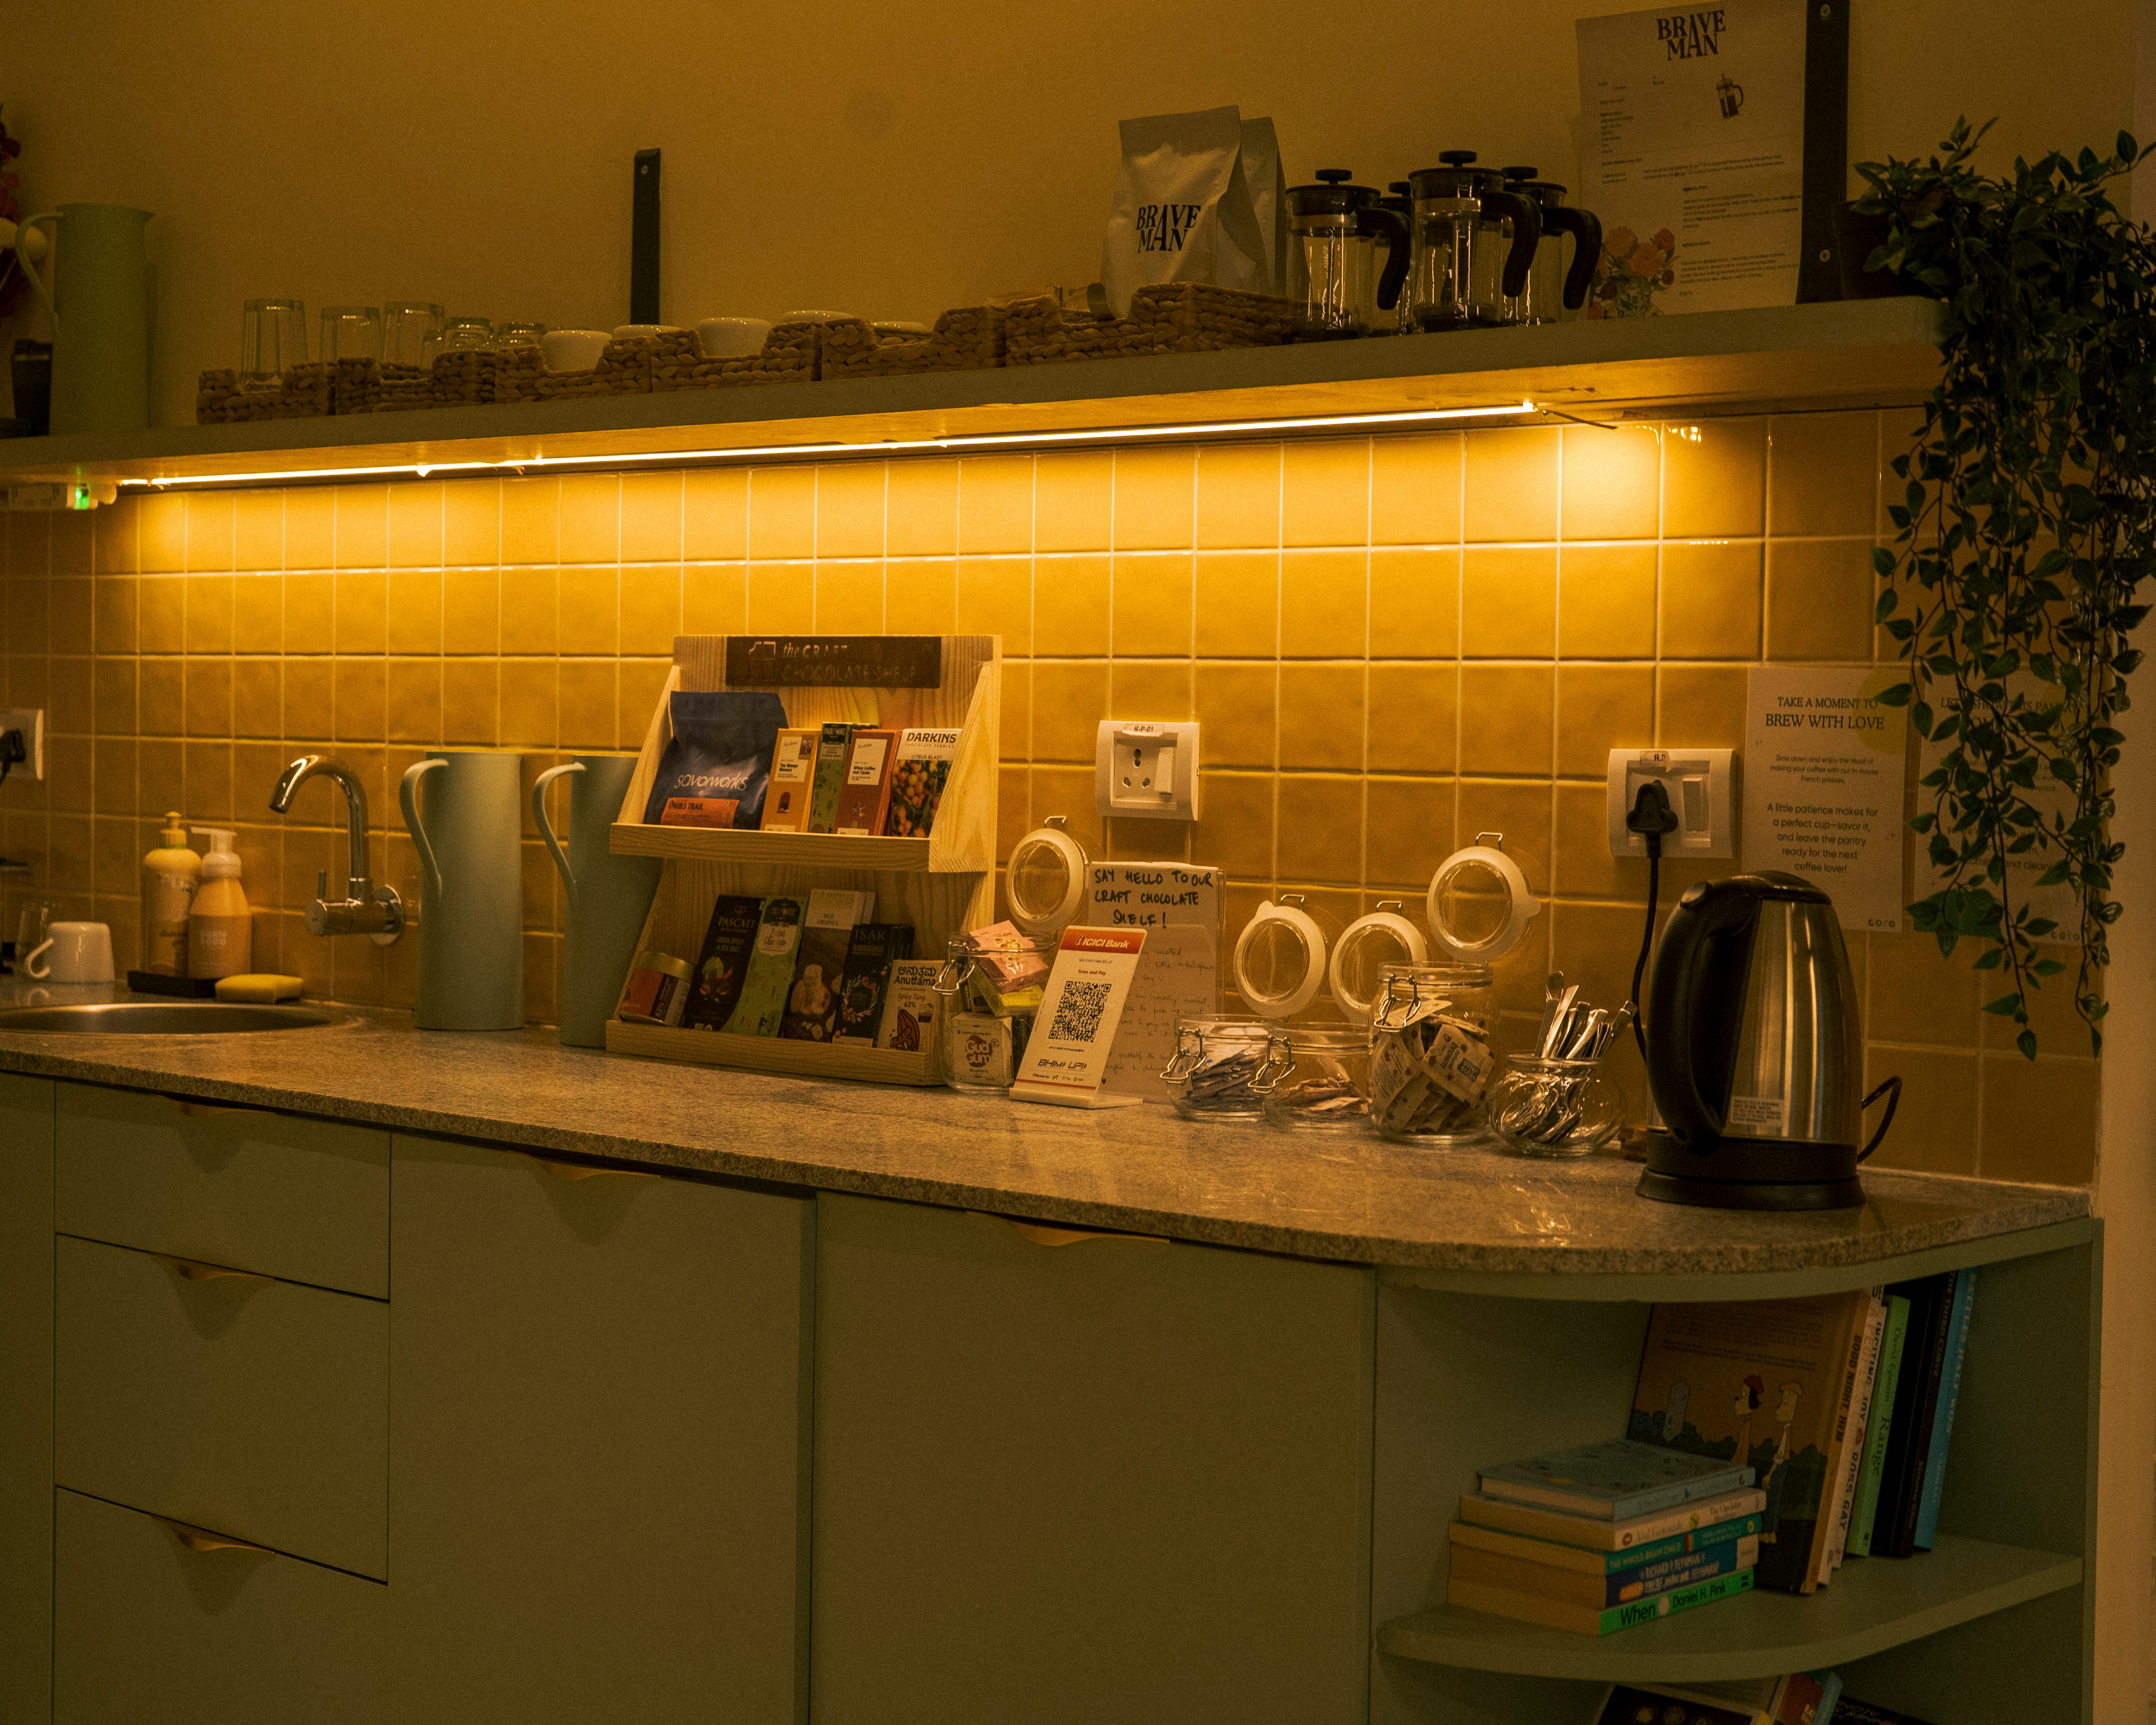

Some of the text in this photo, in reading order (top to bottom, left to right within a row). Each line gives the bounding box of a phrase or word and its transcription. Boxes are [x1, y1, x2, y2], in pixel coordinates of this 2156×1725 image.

[1656, 10, 1726, 40] BRAVE
[1667, 34, 1719, 60] MAN
[1135, 204, 1201, 230] BRAVE
[1138, 229, 1188, 253] MAN
[783, 642, 847, 659] the CRAFT
[1777, 697, 1878, 710] TAKE A MOMENT TO
[1766, 714, 1885, 730] BREW WITH LOVE
[906, 733, 956, 743] DARKINS
[674, 772, 749, 791] savorworks
[688, 802, 703, 810] TRAIL
[1767, 803, 1877, 817] A little patience makes for
[1781, 818, 1811, 828] perfect
[1863, 822, 1871, 832] it,
[1777, 833, 1866, 846] and leave the pantry
[1782, 848, 1806, 858] ready
[1809, 848, 1820, 857] for
[1823, 849, 1836, 858] the
[1794, 862, 1847, 873] coffee lover!
[1094, 869, 1213, 888] SAY HELLO TO OUR
[1094, 890, 1199, 906] CRAFT CHOCOLATE
[718, 916, 755, 929] PASCATI
[855, 929, 885, 940] ISAK
[1082, 938, 1130, 948] ICICI Bank
[913, 994, 926, 1002] Tang
[1038, 1059, 1063, 1067] BHIM
[1440, 1041, 1459, 1069] brown
[1932, 1272, 1955, 1377] THE THIRD CURVE
[1849, 1334, 1861, 1369] GOOD
[1884, 1327, 1902, 1402] David Epstein
[1953, 1348, 1965, 1389] HALF
[1946, 1398, 1957, 1433] WON
[1835, 1414, 1846, 1442] HEM
[1871, 1416, 1890, 1476] Range
[1839, 1500, 1850, 1531] GAY
[1609, 1559, 1621, 1568] THE
[1645, 1553, 1701, 1579] RICHARD FEYNMAN
[1620, 1581, 1726, 1626] When Daniel H. Pink
